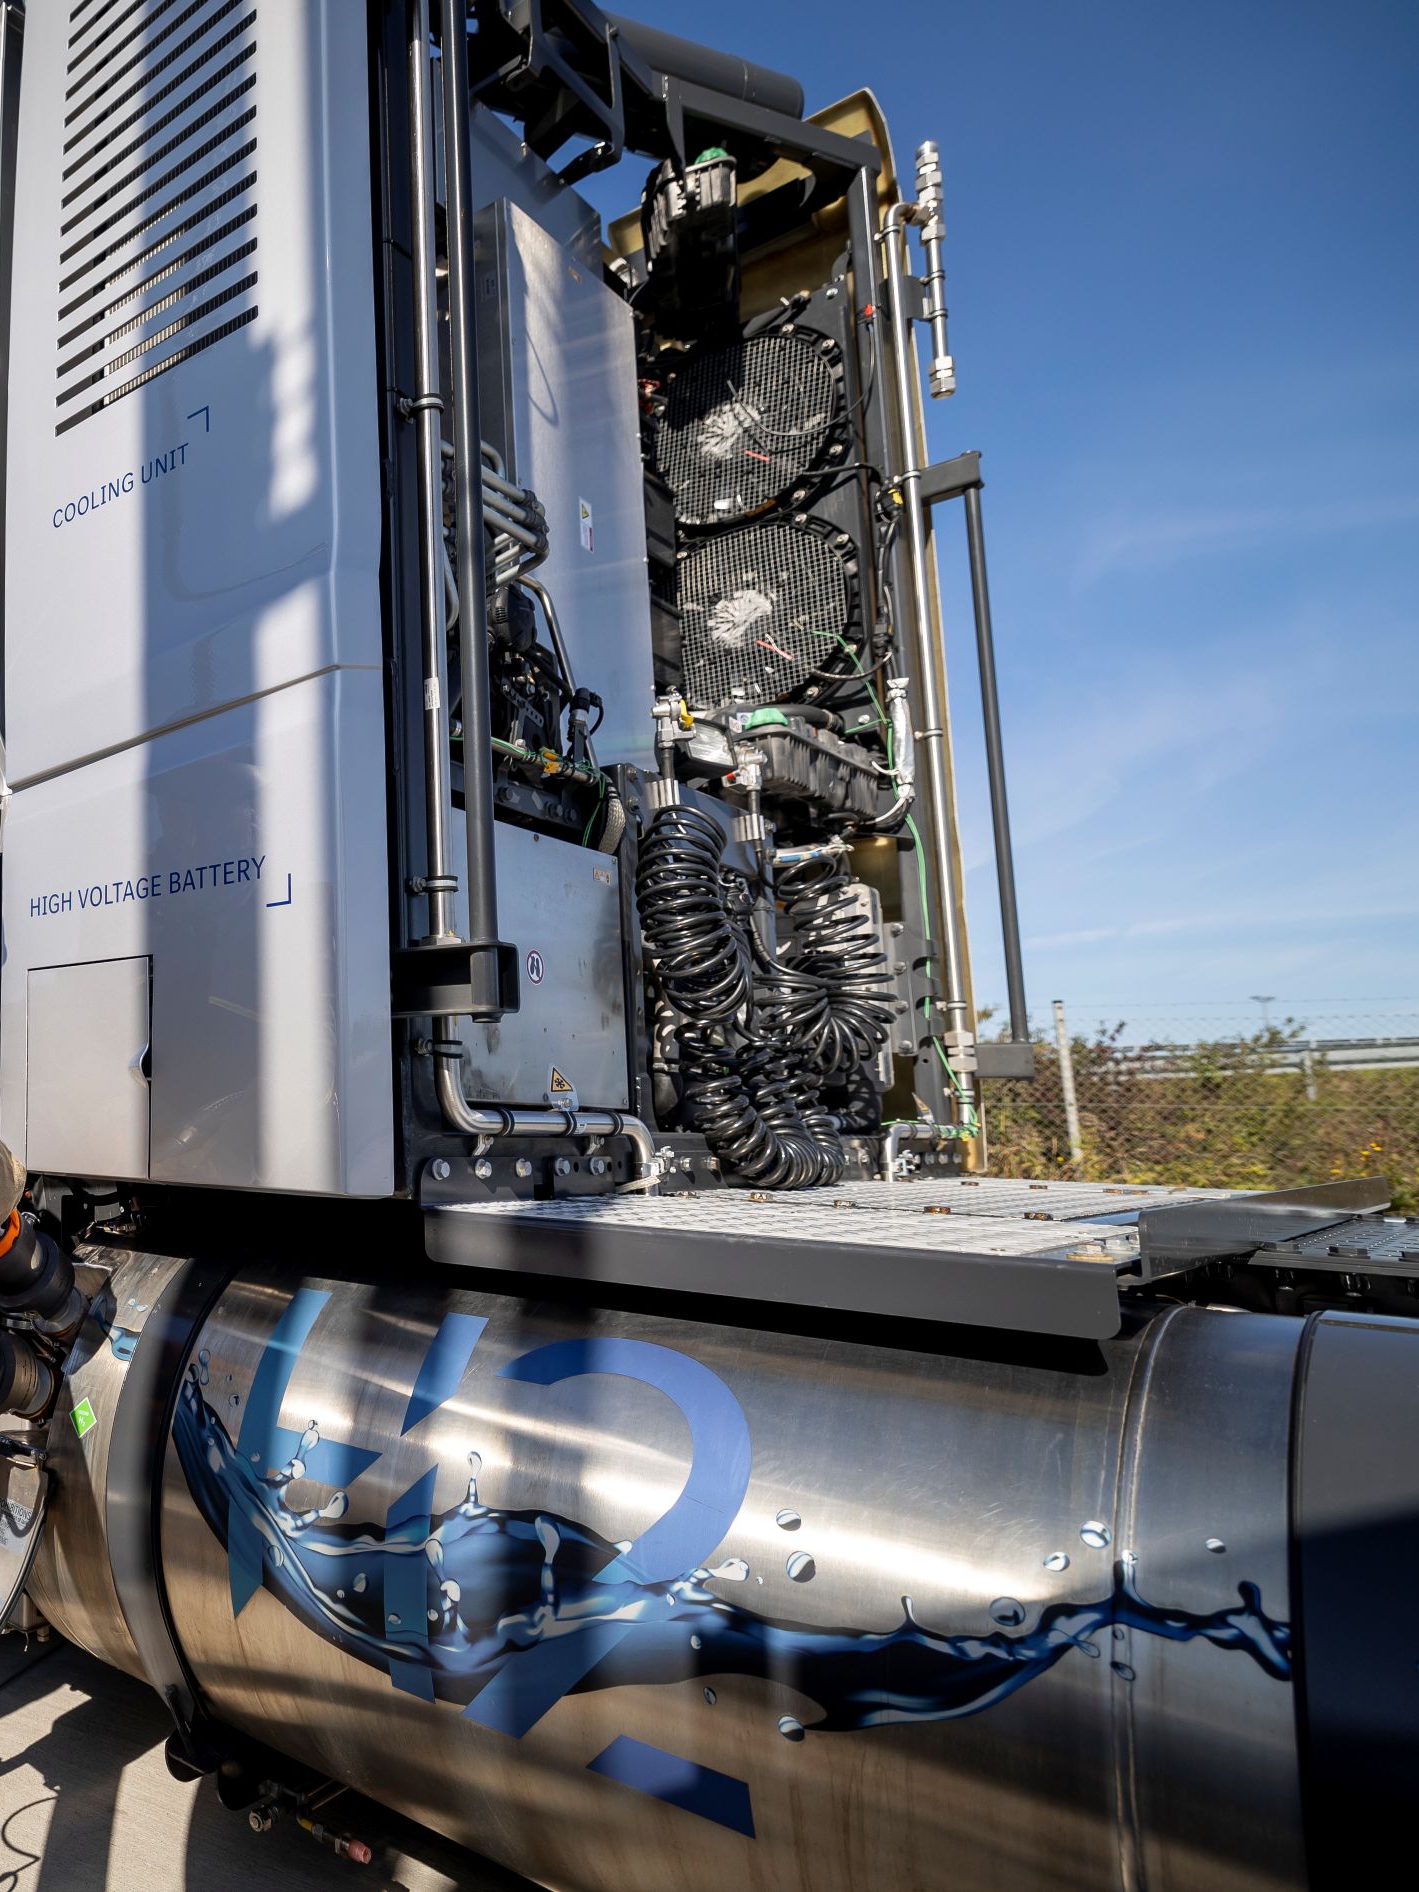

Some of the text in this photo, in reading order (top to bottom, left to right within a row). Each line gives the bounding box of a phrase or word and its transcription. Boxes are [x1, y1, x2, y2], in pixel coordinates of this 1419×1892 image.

[52, 442, 189, 529] COOLING UNIT
[30, 855, 266, 918] HIGH VOLTAGE BATTERY
